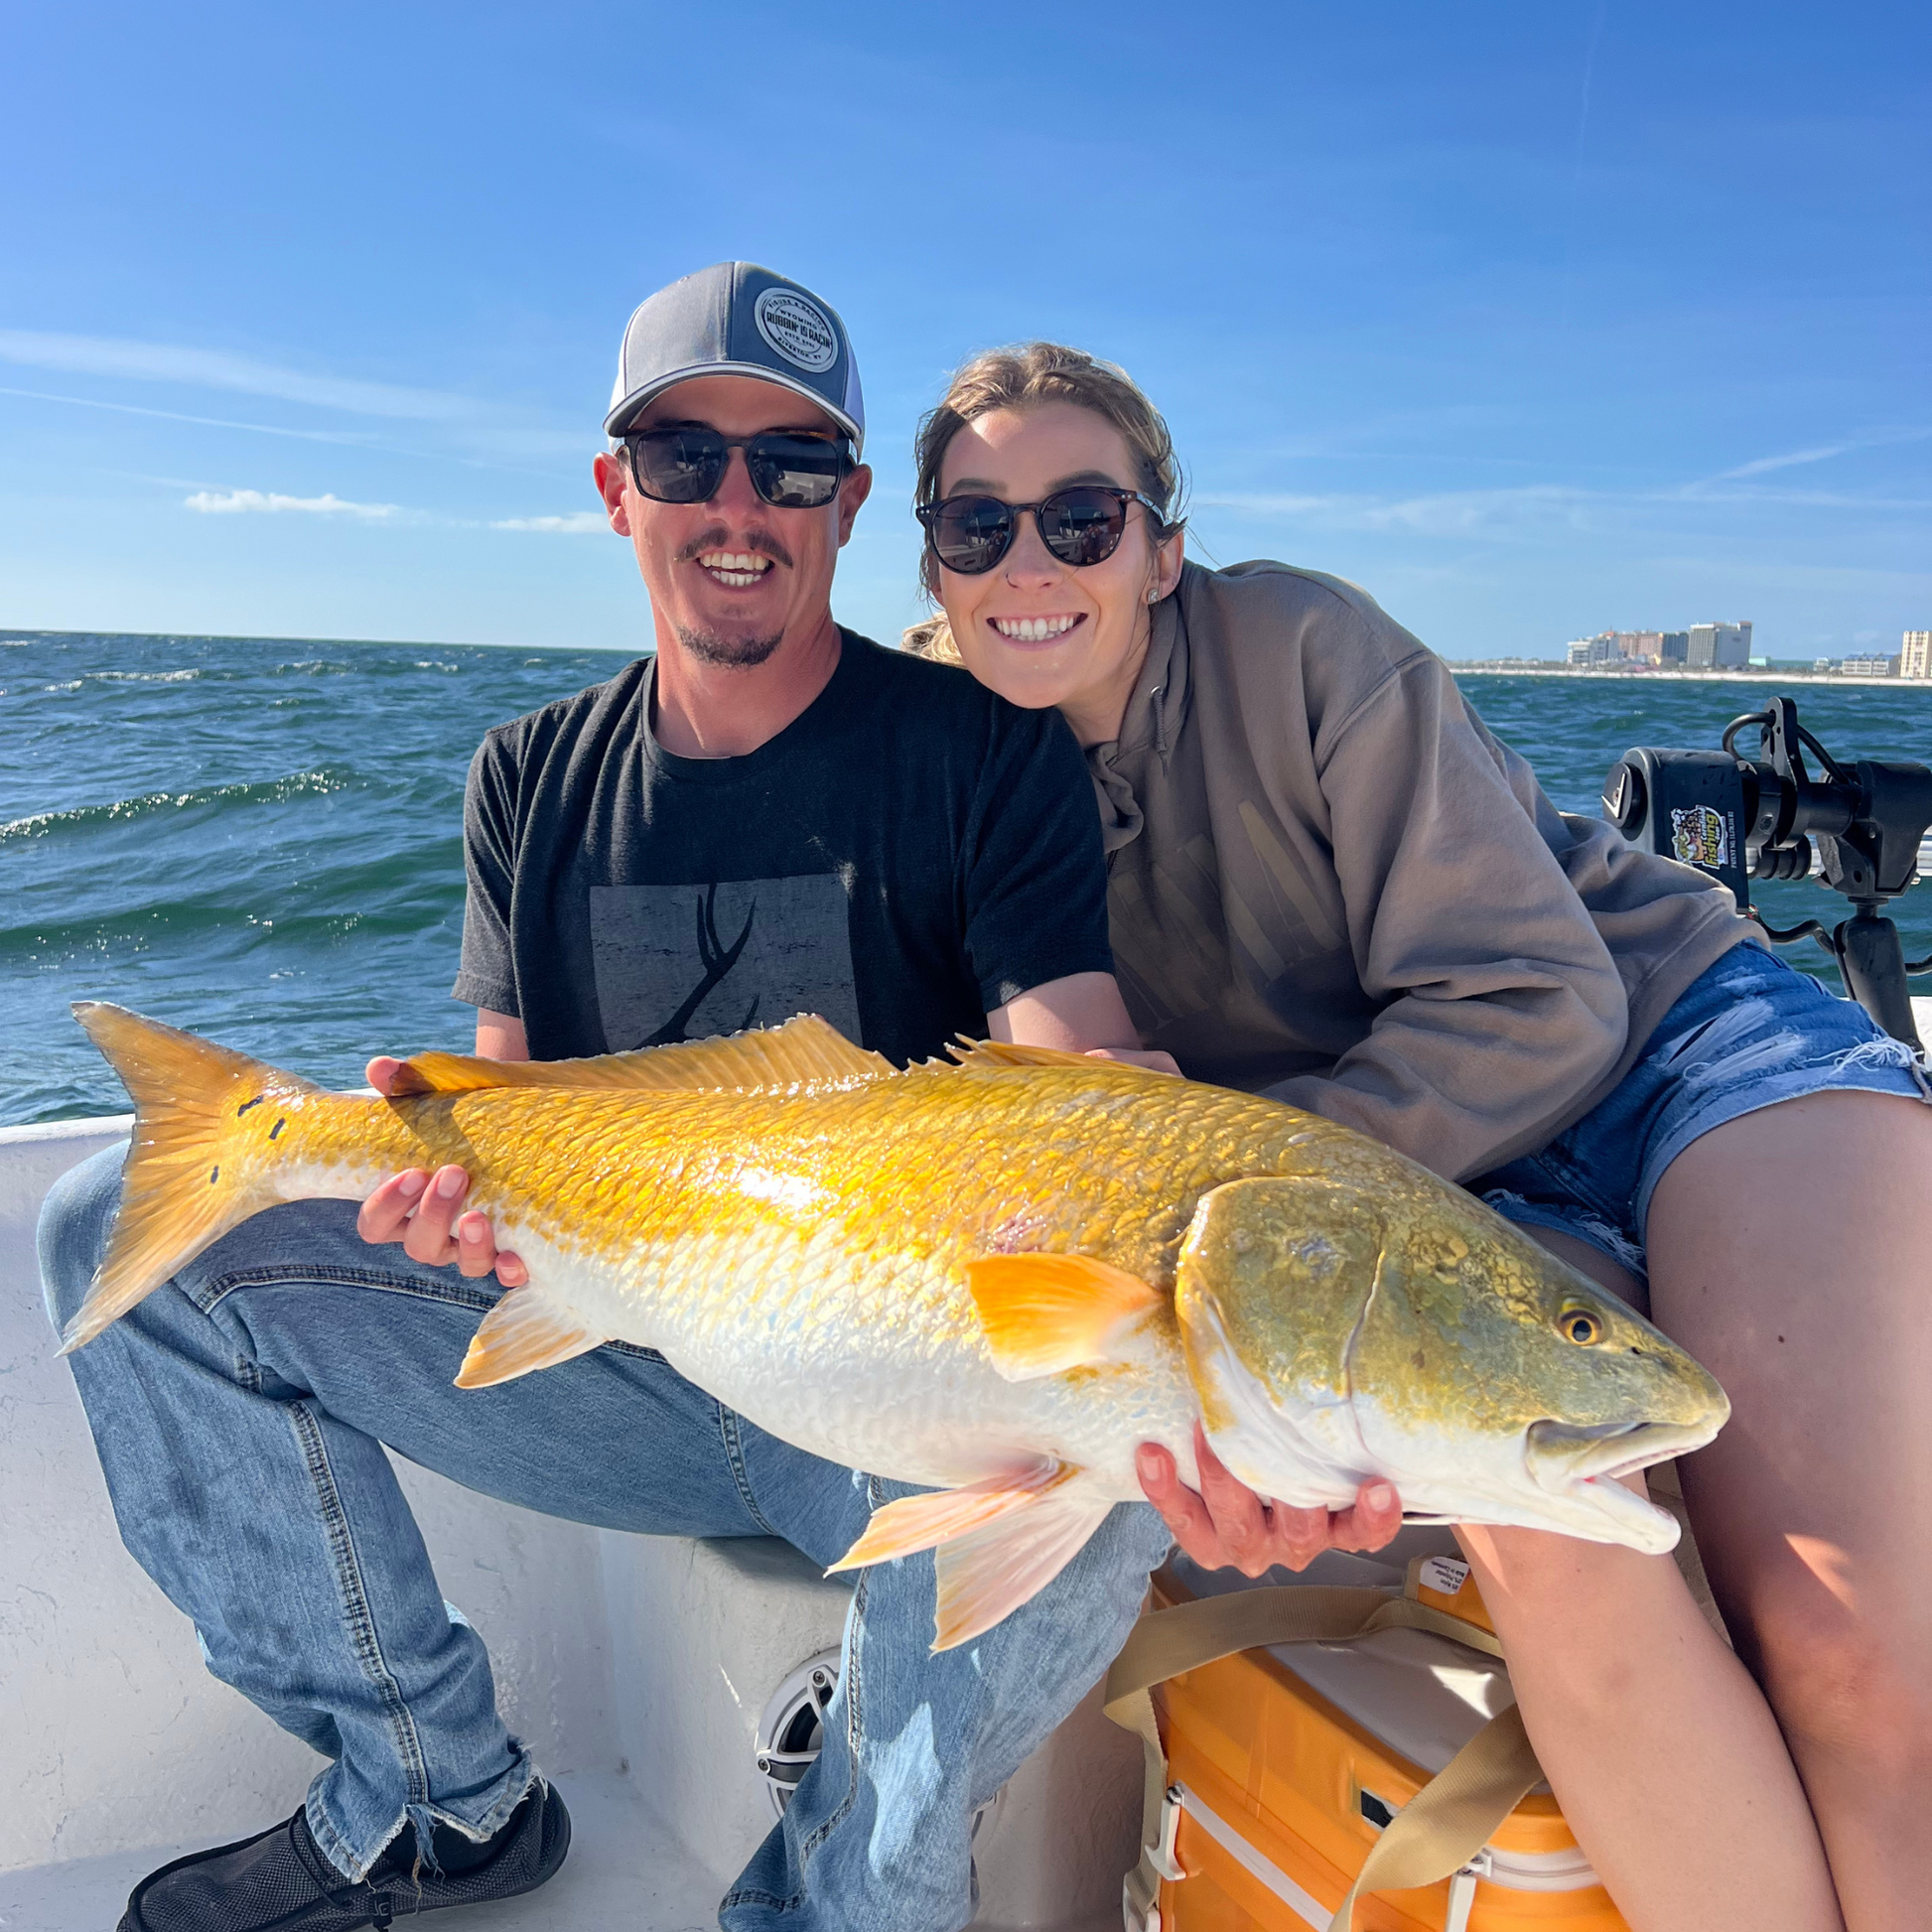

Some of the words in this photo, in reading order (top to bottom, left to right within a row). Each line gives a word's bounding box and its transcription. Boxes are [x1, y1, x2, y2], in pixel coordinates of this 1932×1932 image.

[779, 309, 817, 330] WYOMING
[800, 325, 808, 338] IS
[1699, 807, 1708, 841] Cornfield
[1703, 813, 1719, 866] Fishing
